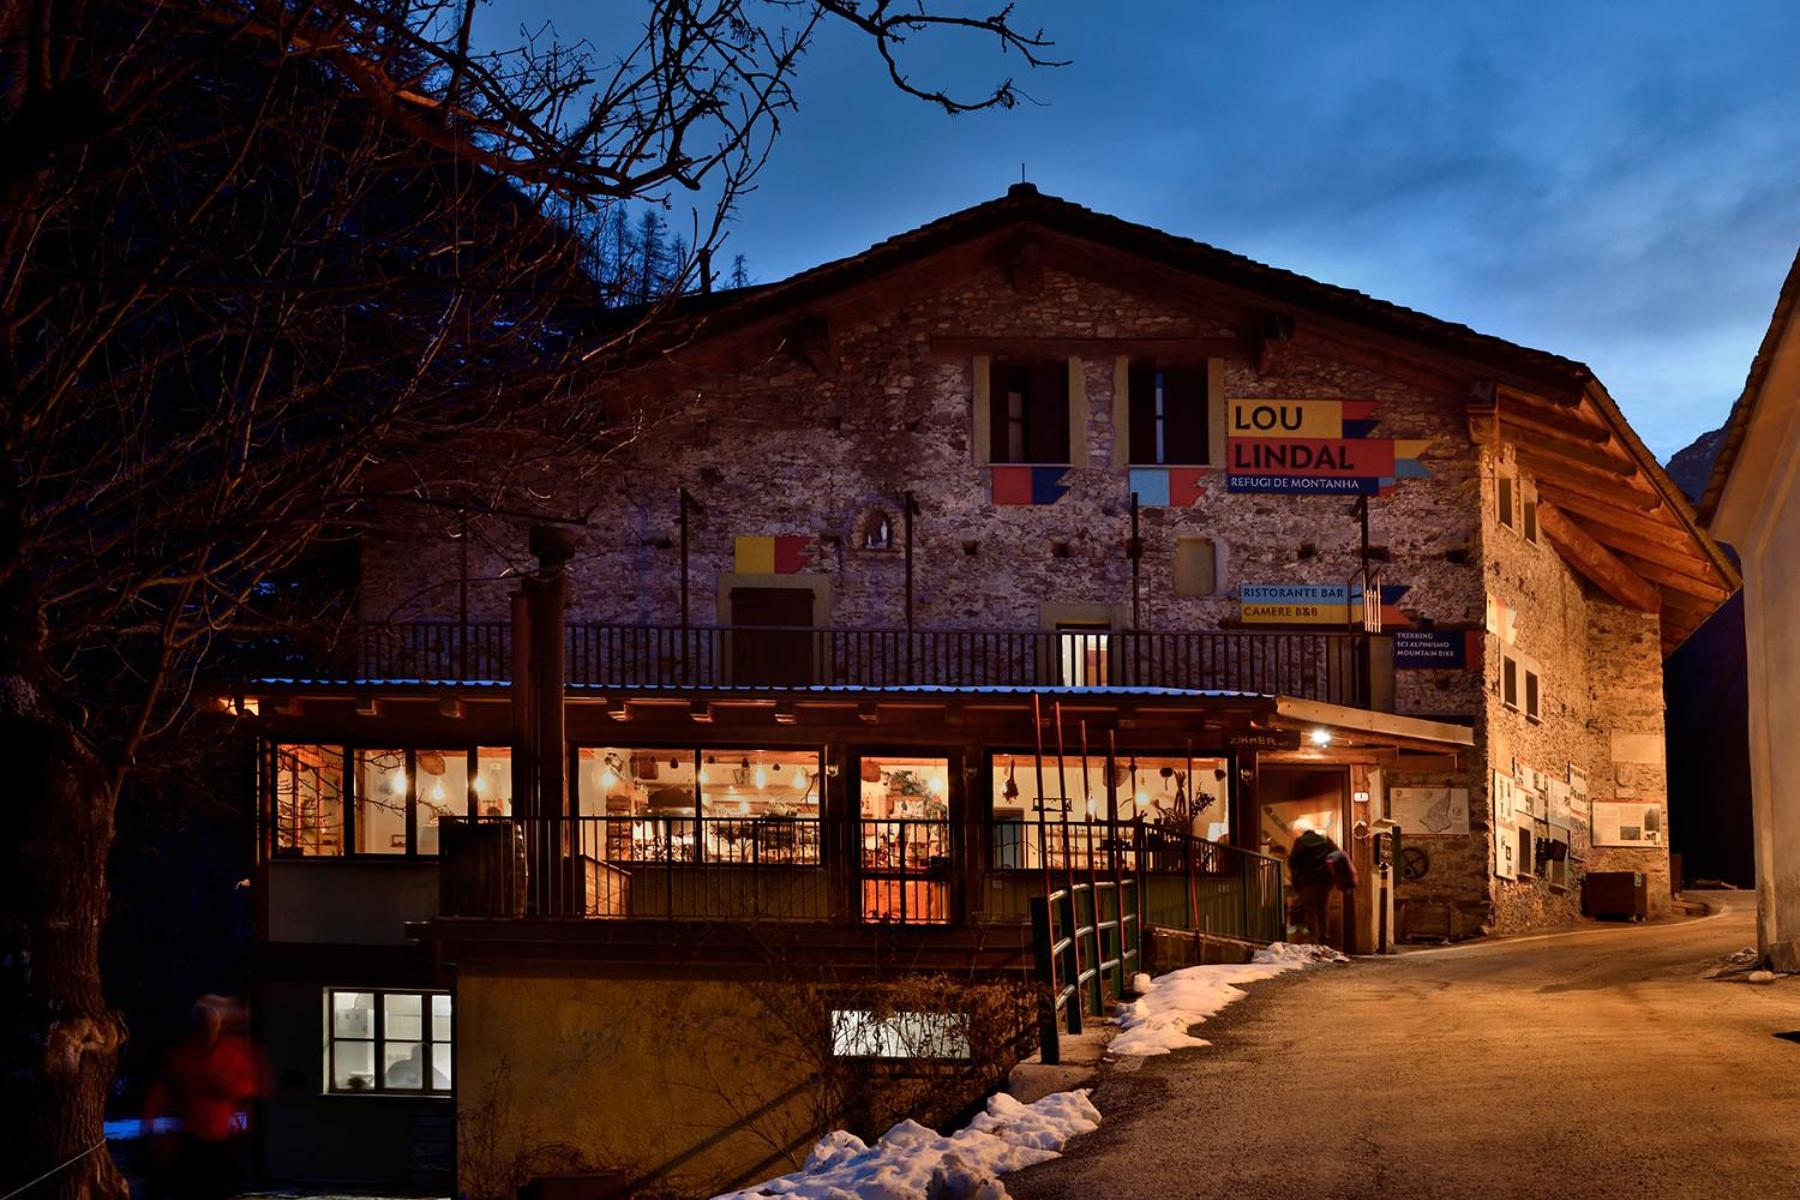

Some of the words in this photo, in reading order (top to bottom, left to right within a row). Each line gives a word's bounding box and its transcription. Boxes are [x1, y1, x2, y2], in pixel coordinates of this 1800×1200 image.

[1235, 405, 1303, 431] LOU
[1235, 444, 1355, 470] LINDAL
[1231, 477, 1271, 487] REFUGI
[1274, 478, 1289, 488] DE
[1291, 478, 1360, 489] MONTANHA
[1243, 587, 1318, 598] RISTORANTE
[1321, 588, 1344, 598] BAR
[1243, 606, 1293, 617] CAMERE
[1295, 606, 1318, 617] B&B
[1396, 632, 1434, 640] TREKKING
[1396, 649, 1437, 657] MOUNTAIN
